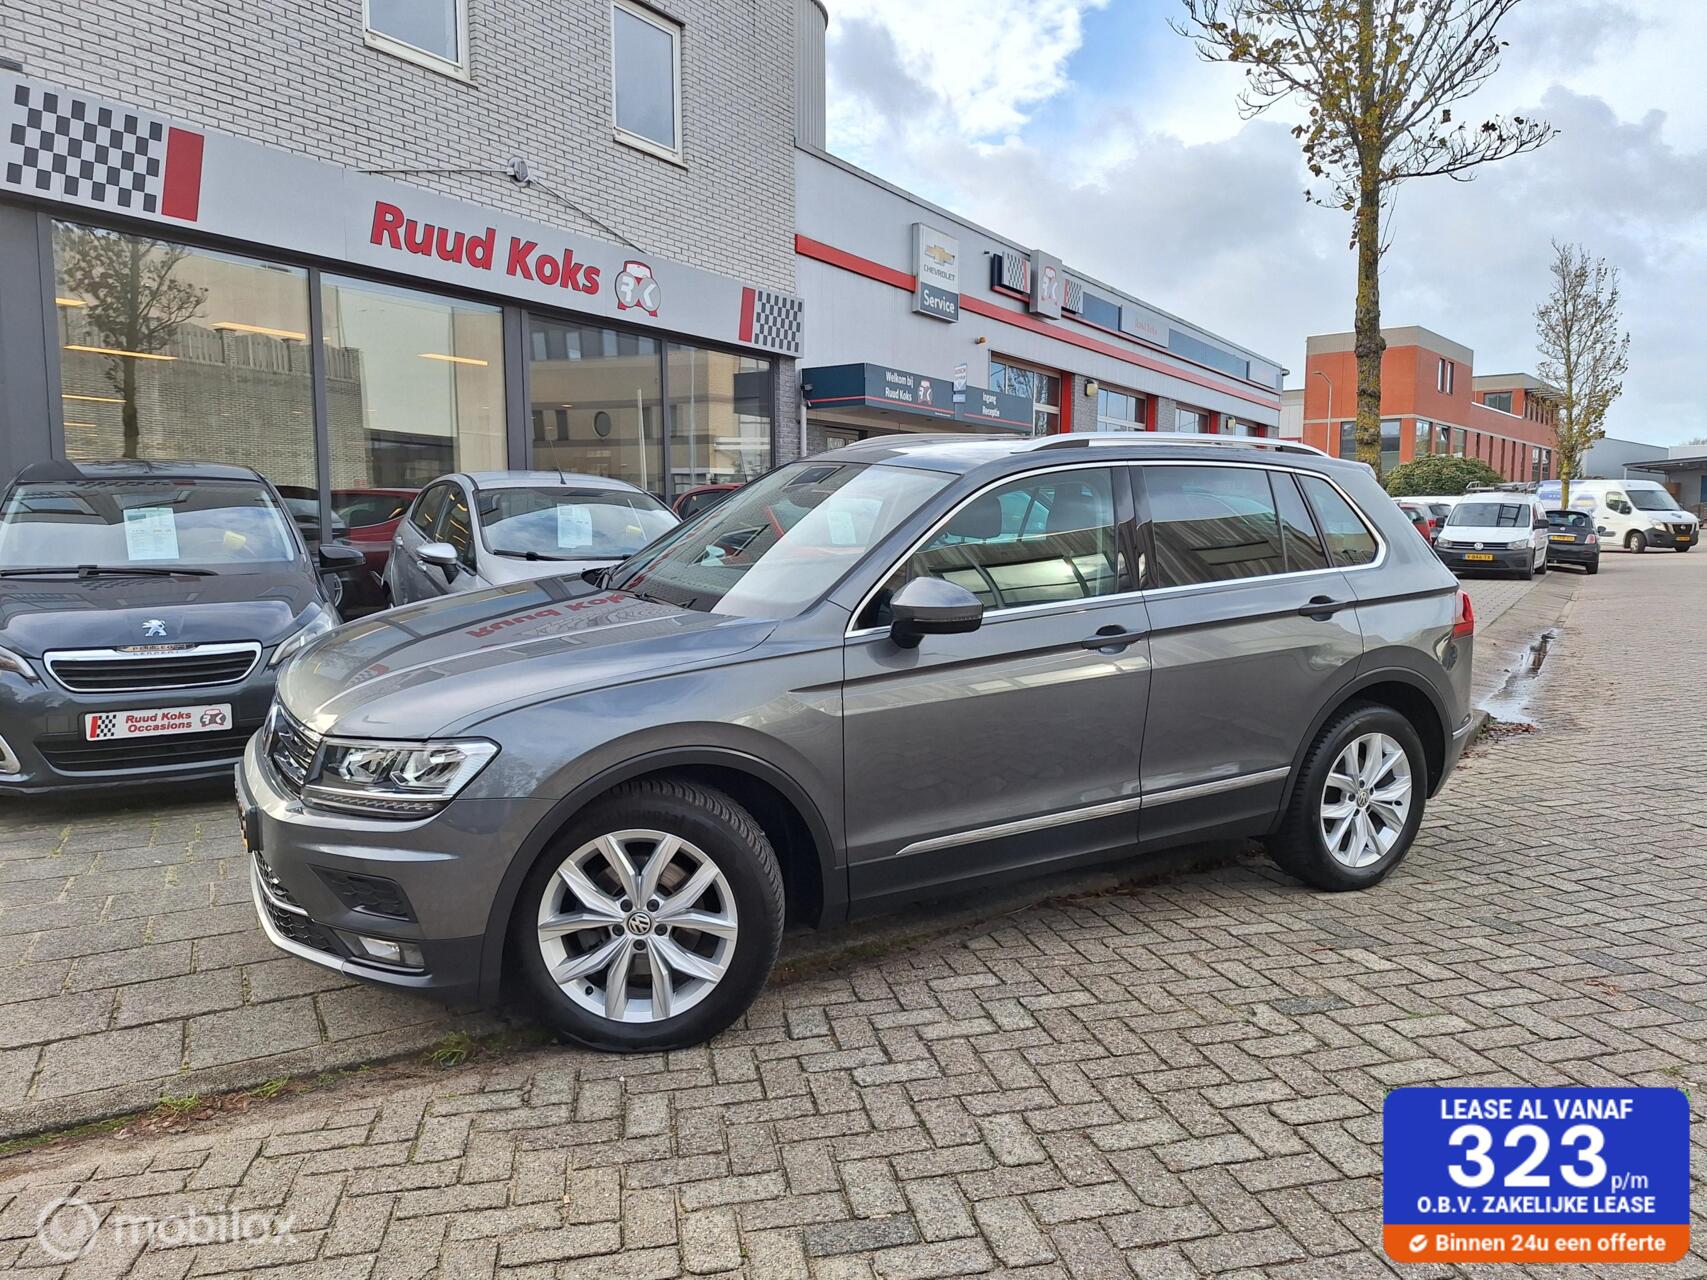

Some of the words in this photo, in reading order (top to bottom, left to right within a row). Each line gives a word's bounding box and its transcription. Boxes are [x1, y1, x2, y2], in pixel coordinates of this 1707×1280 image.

[370, 200, 496, 270] Ruud
[506, 237, 601, 296] Koks
[923, 264, 956, 281] CHEVROLET
[923, 289, 955, 314] Service
[885, 371, 906, 385] Welkom
[906, 375, 914, 389] bij
[885, 387, 899, 400] Ruud
[899, 389, 913, 402] Koks
[125, 713, 160, 724] Ruud
[161, 711, 192, 722] Koks
[127, 720, 193, 733] Occasions
